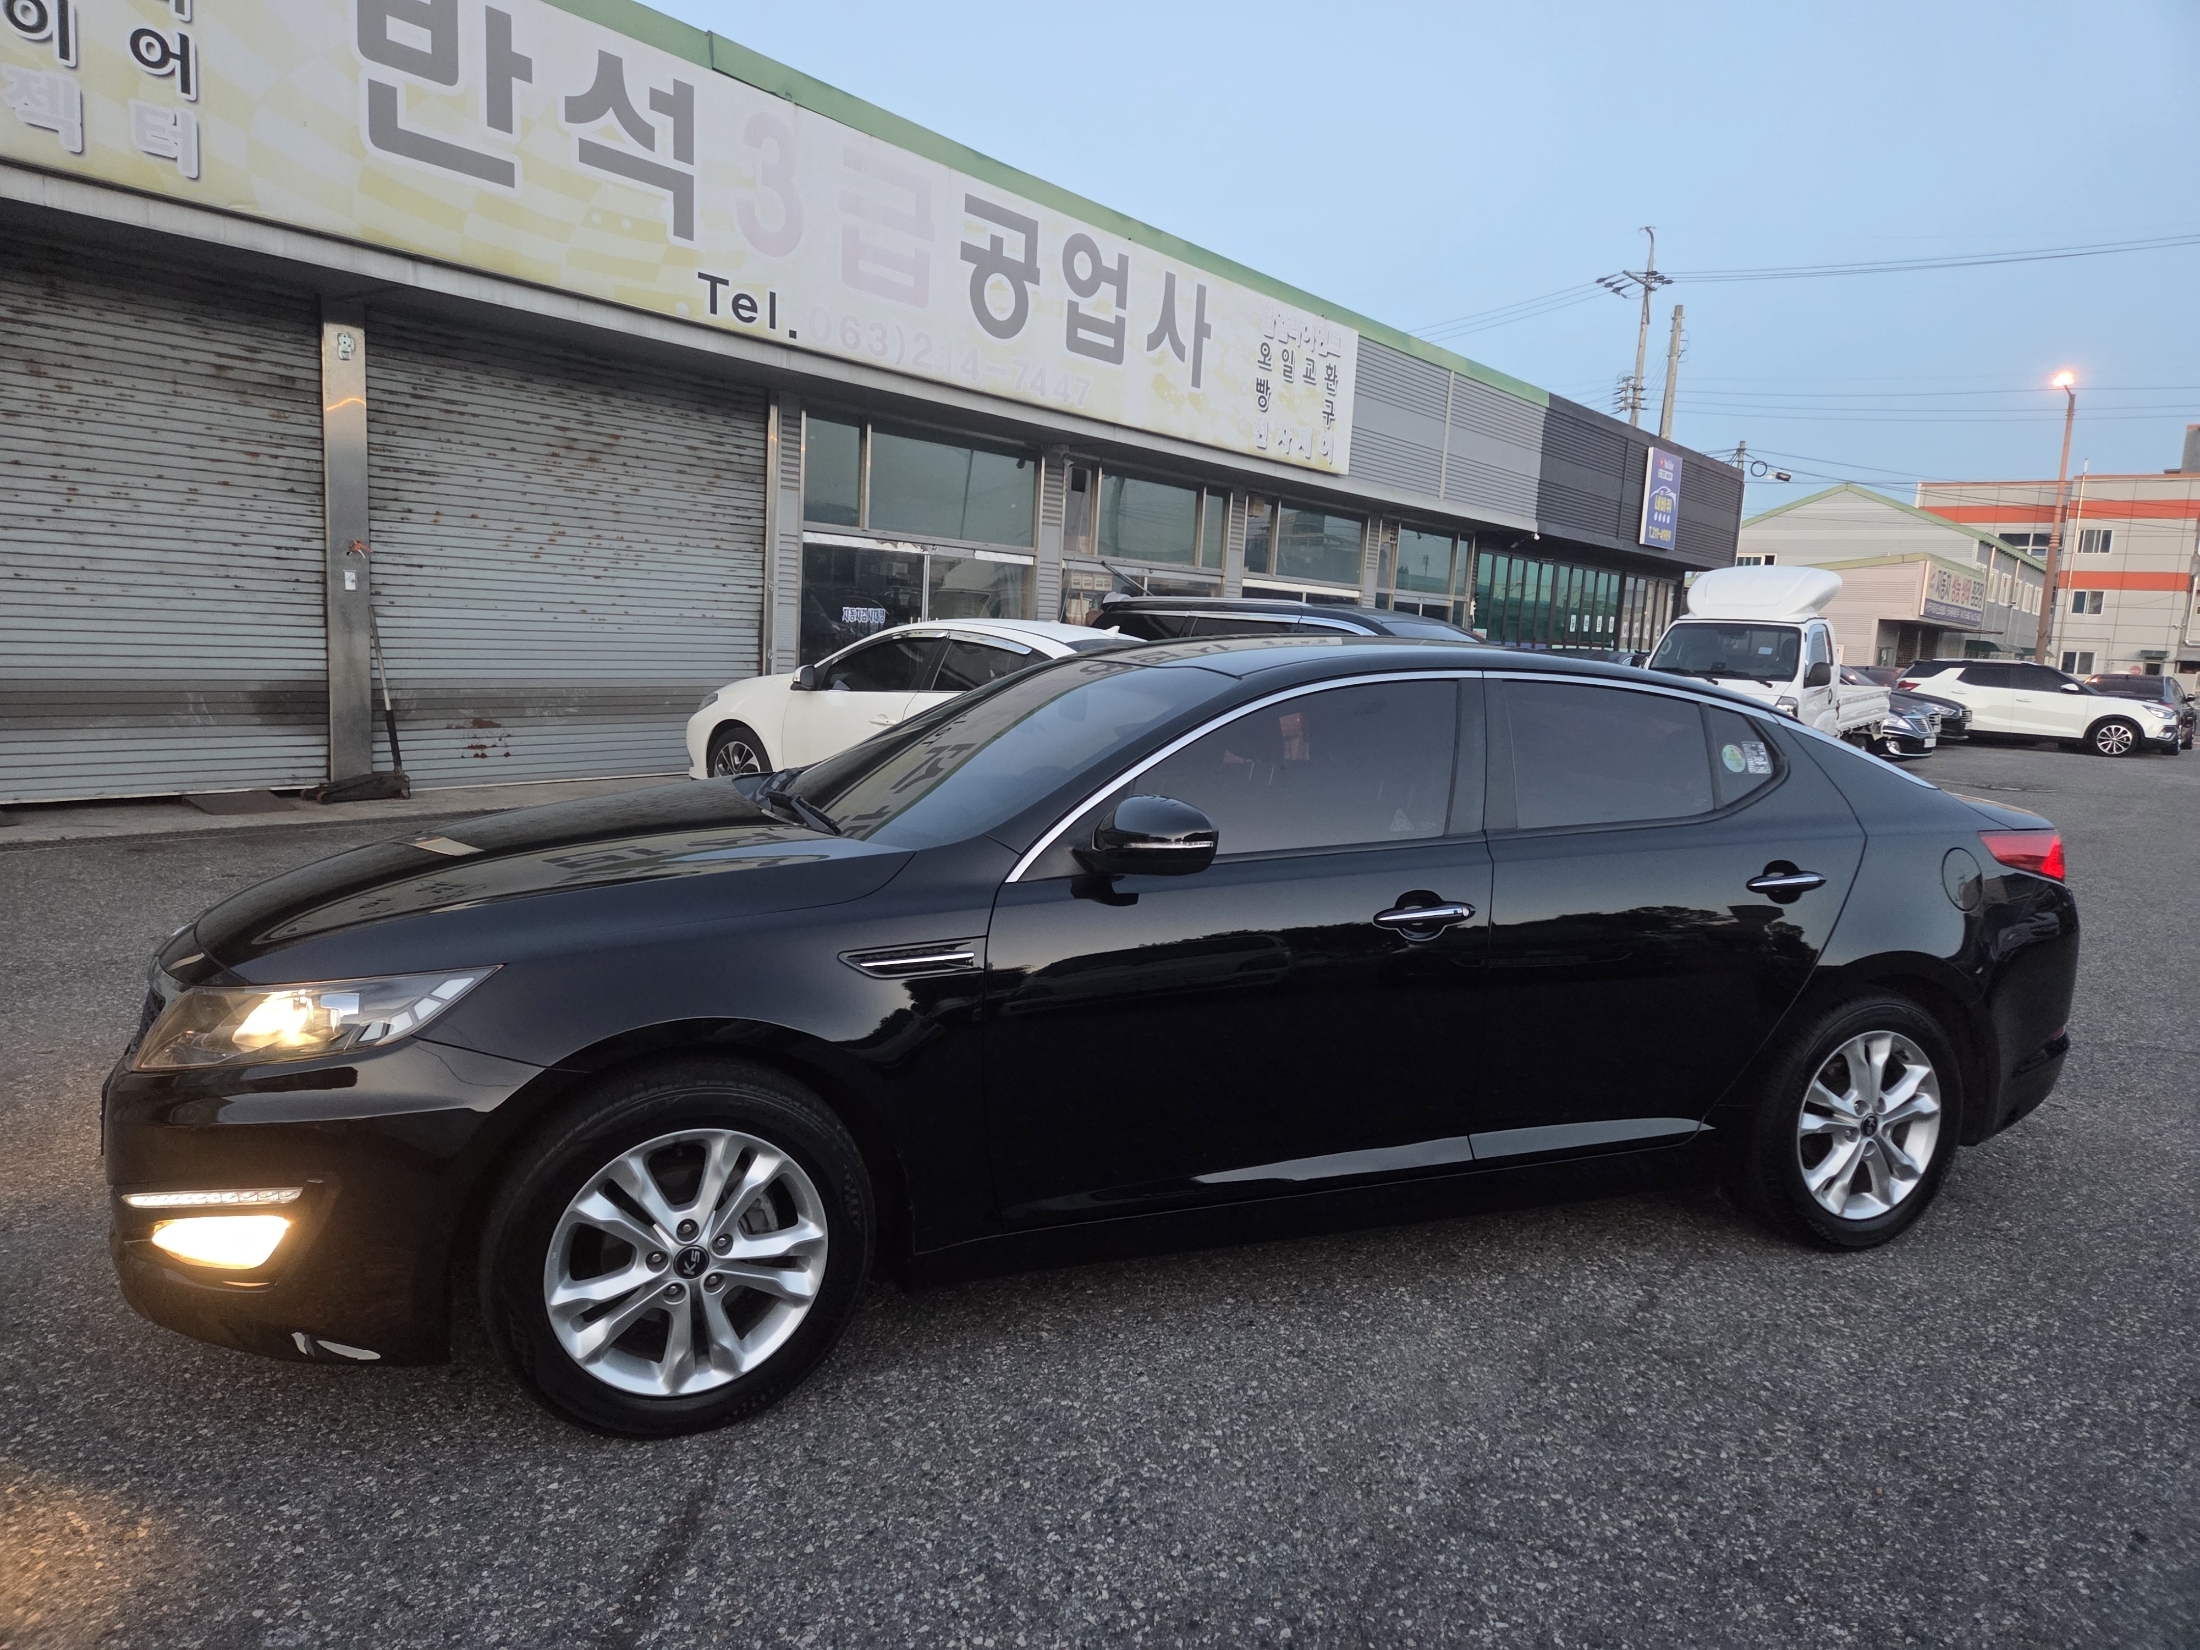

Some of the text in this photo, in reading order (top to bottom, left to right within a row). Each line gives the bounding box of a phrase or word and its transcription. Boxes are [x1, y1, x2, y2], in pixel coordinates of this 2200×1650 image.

[357, 0, 696, 242] 반석
[959, 192, 1212, 390] 공업사
[697, 271, 798, 339] Tel.
[683, 1250, 700, 1276] K5
